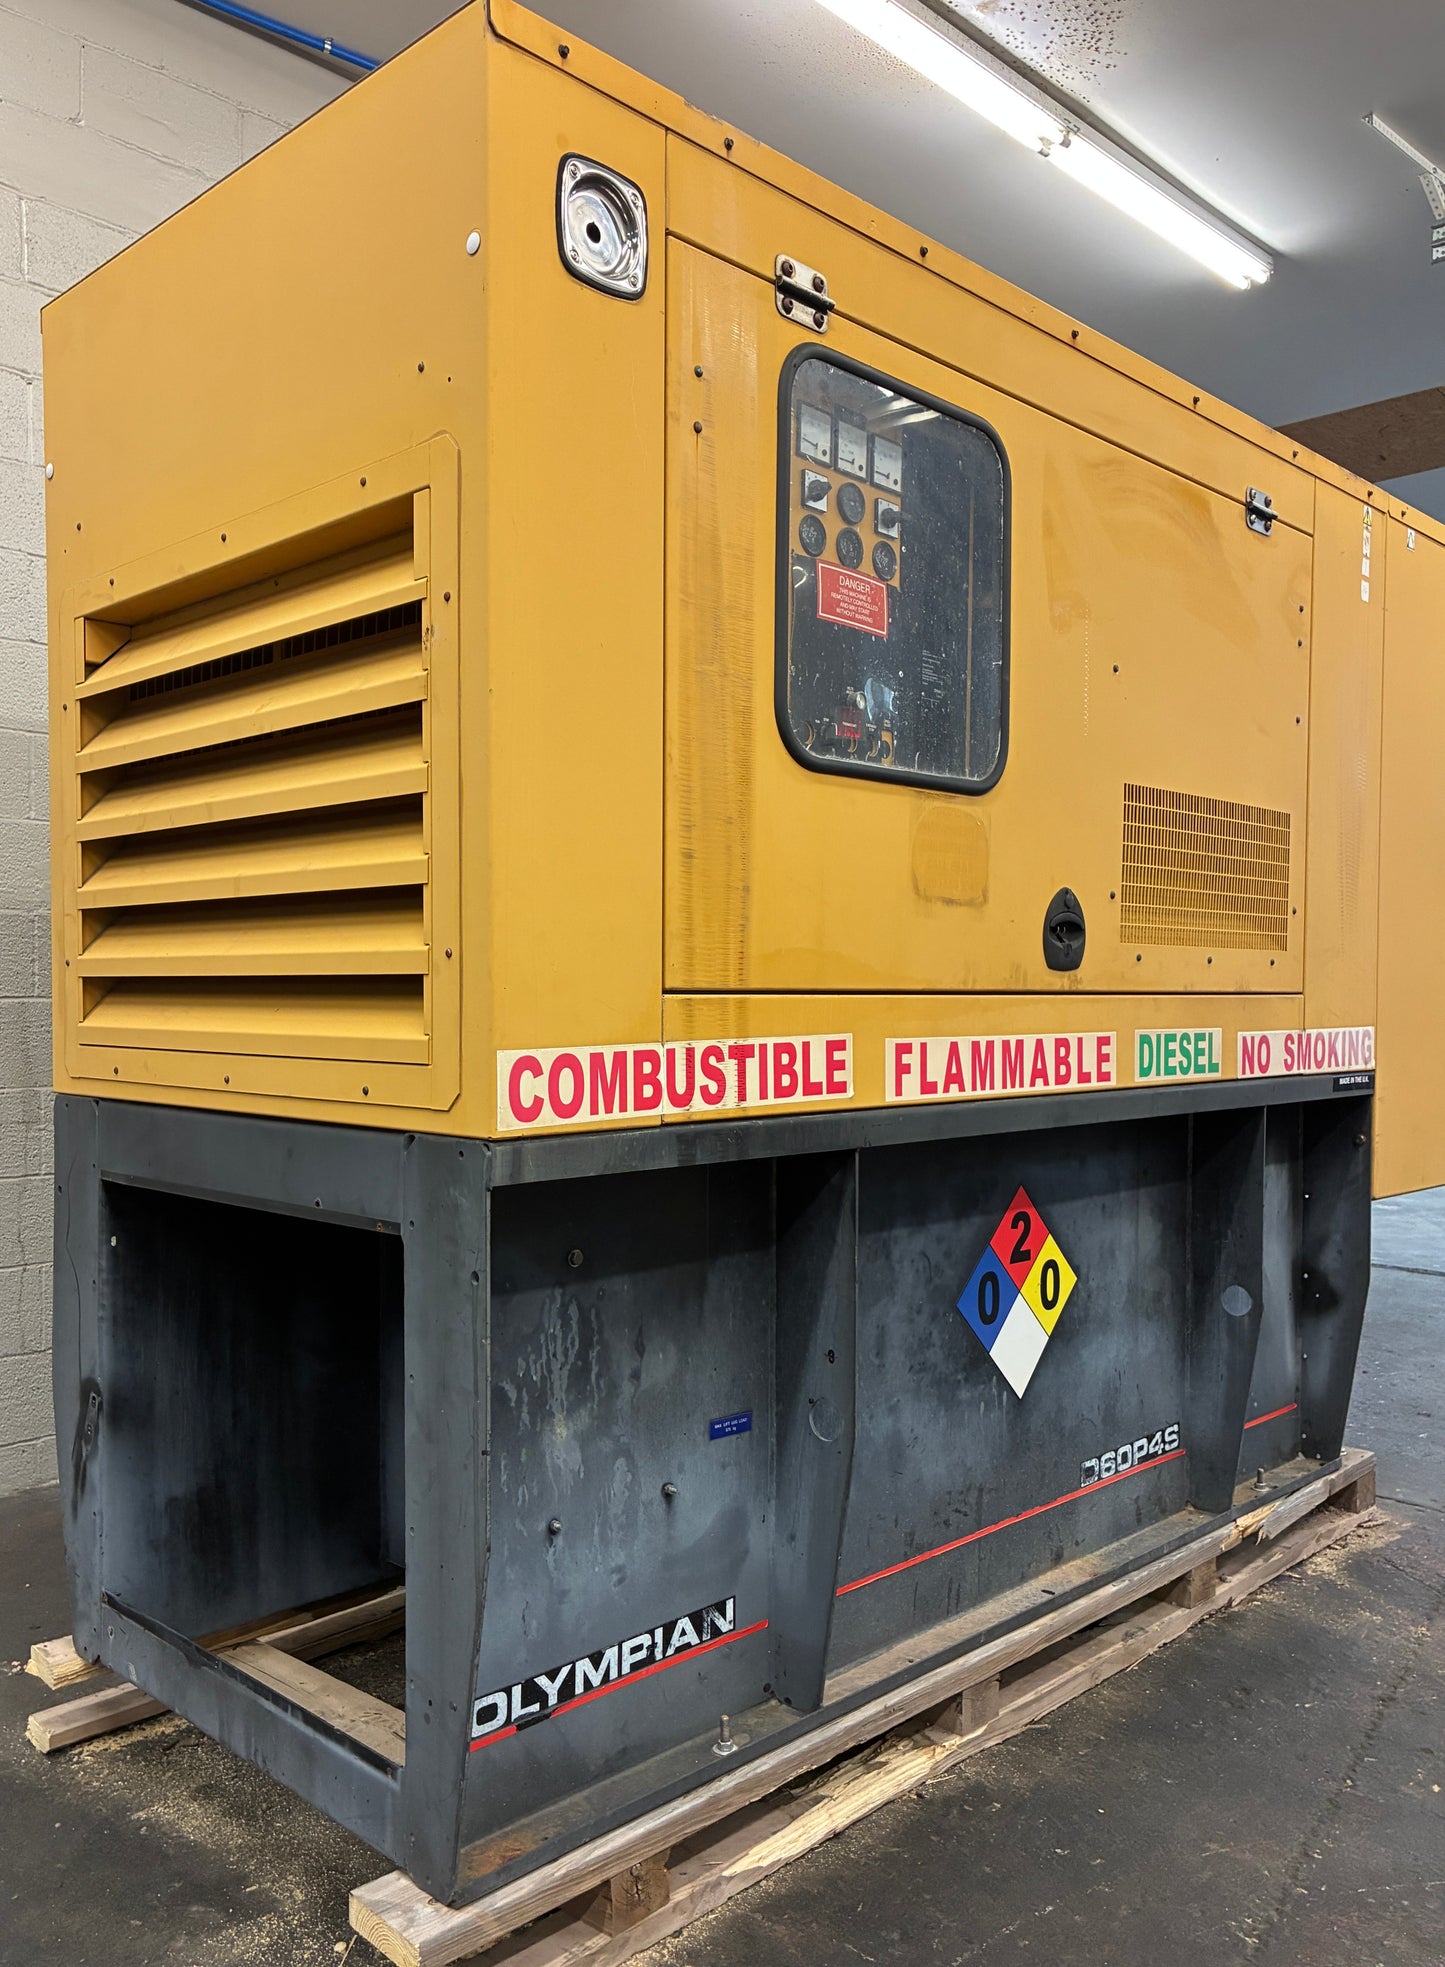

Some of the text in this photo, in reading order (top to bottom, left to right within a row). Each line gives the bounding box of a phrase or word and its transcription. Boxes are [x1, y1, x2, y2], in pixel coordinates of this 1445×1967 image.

[831, 592, 879, 612] REMOTELY CONTROLLED
[840, 576, 870, 595] DANGER
[836, 608, 855, 618] WITHOUT
[894, 1035, 1112, 1097] FLAMMABLE
[1138, 1032, 1220, 1078] DIESEL
[1241, 1029, 1373, 1076] NO SMOKING
[508, 1039, 848, 1123] COMBUSTIBLE
[1009, 1211, 1031, 1264] 2
[977, 1270, 1000, 1326] 0
[1040, 1258, 1060, 1310] 0
[1081, 1424, 1180, 1488] D60P4S
[471, 1597, 734, 1738] OLYMPIAN
